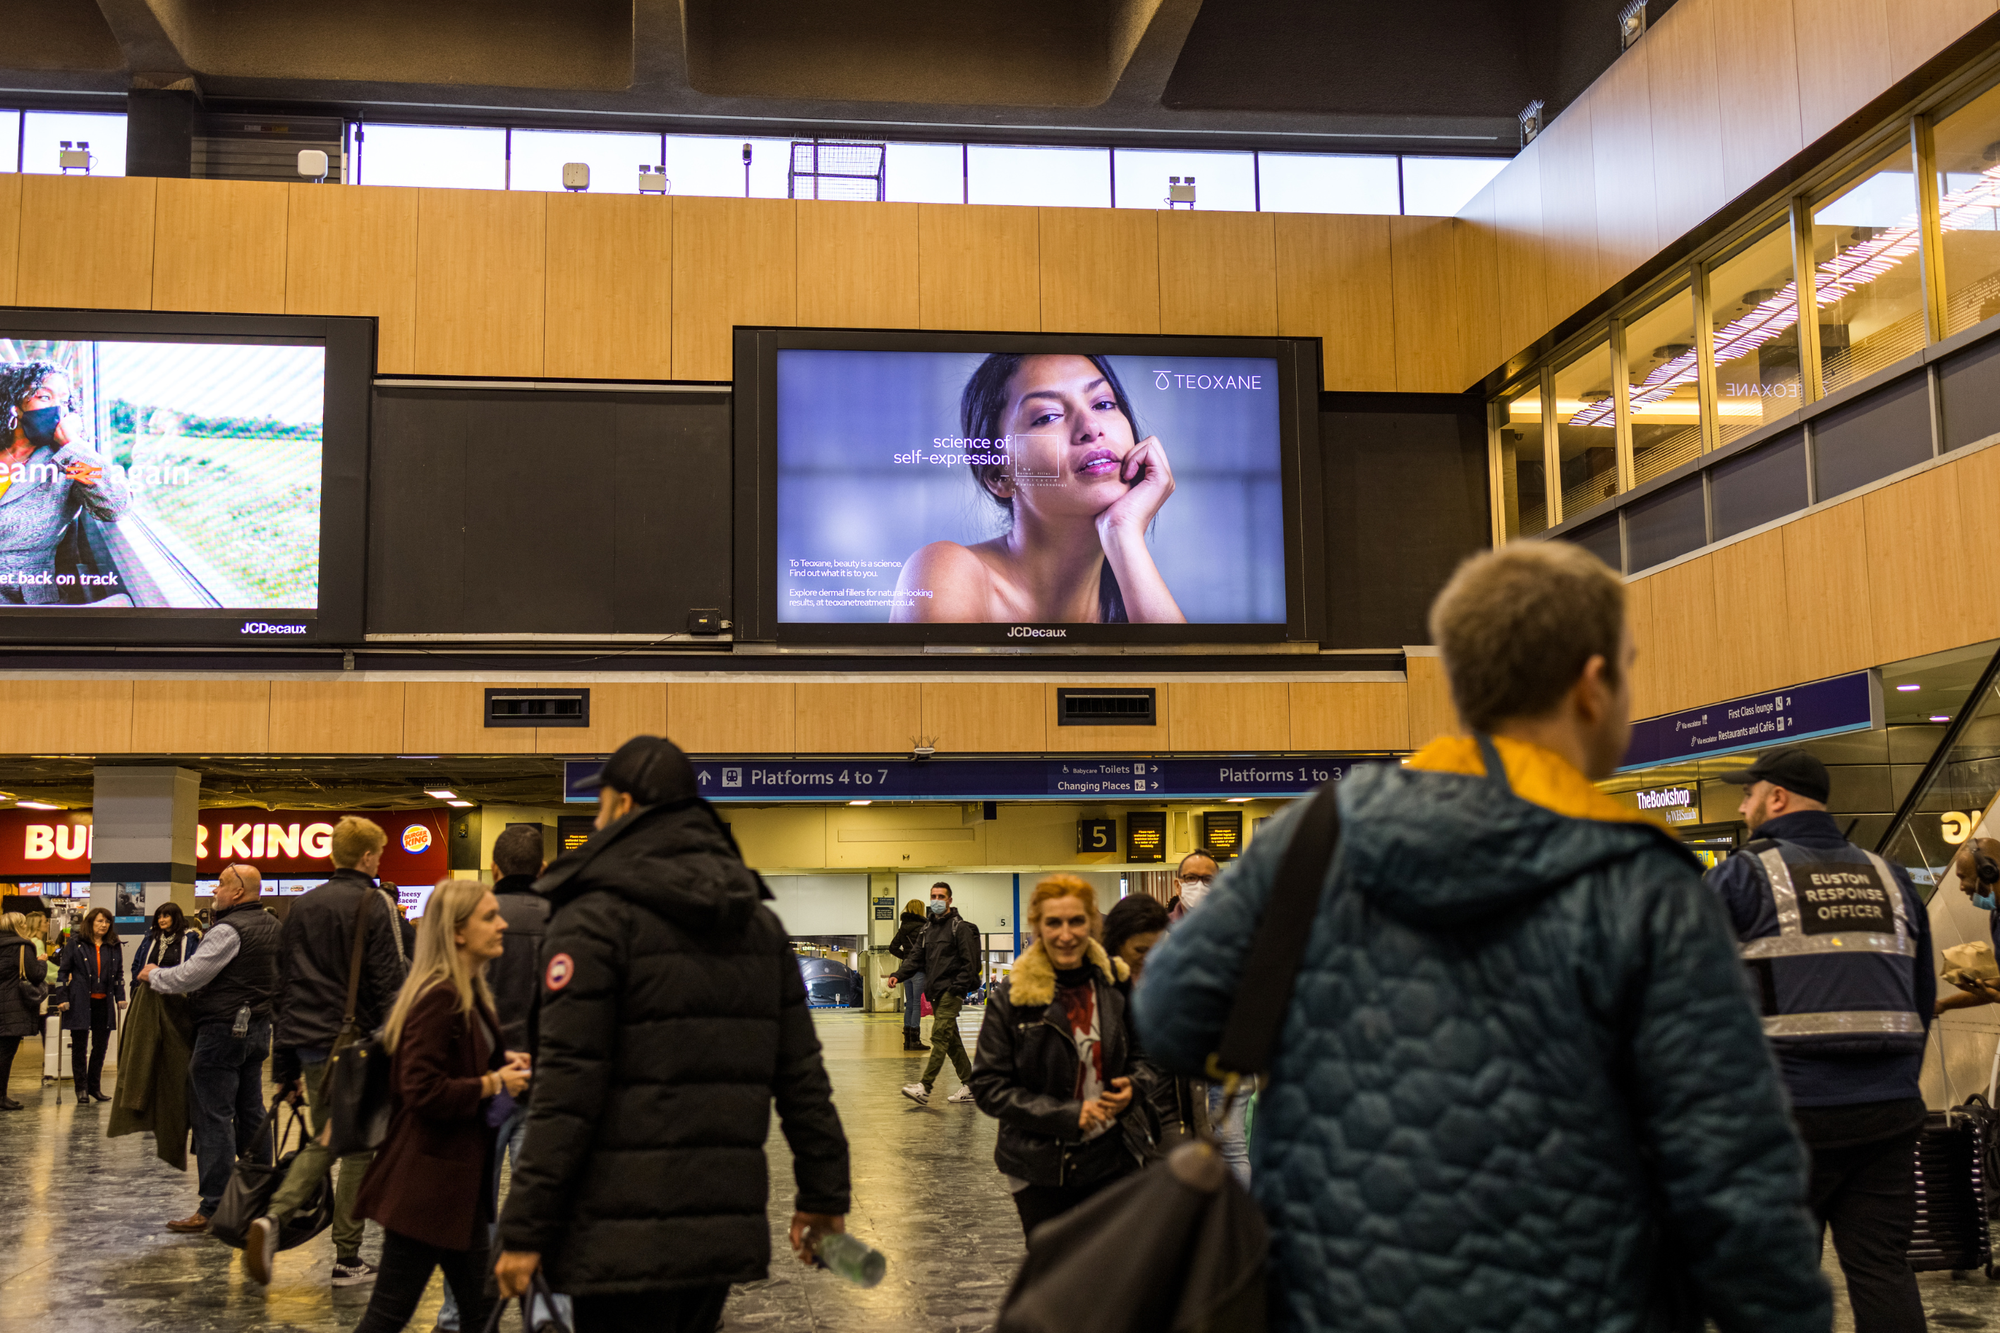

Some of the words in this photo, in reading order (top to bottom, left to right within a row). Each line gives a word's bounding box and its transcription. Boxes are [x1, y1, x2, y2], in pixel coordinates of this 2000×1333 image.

[1173, 374, 1262, 390] TEOXANE
[933, 434, 991, 449] science
[994, 434, 1011, 449] of
[893, 449, 1011, 468] self-expression
[110, 459, 190, 492] again
[789, 559, 799, 568] To
[800, 559, 833, 568] Teoxane,
[834, 559, 860, 569] beauty
[873, 559, 903, 568] science.
[18, 570, 53, 585] back
[56, 573, 76, 585] on
[79, 571, 119, 586] track
[789, 569, 806, 577] Find
[821, 569, 839, 577] what
[840, 569, 846, 577] it
[862, 571, 878, 579] you.
[789, 588, 818, 599] Explore
[818, 588, 845, 597] dermal
[845, 588, 865, 597] fillers
[866, 588, 878, 597] for
[878, 588, 933, 599] natural-looking
[789, 598, 815, 607] results,
[241, 622, 307, 635] JCDecaux
[1007, 626, 1067, 638] JCDecaux
[1728, 709, 1741, 720] First
[1740, 706, 1755, 717] Class
[1754, 702, 1774, 714] lounge
[1718, 727, 1748, 741] Restaurants
[1748, 723, 1759, 735] and
[1759, 720, 1775, 733] Cafés
[751, 769, 834, 785] Platforms
[838, 769, 850, 785] 4
[854, 771, 873, 785] to
[877, 769, 888, 785] 7
[1072, 767, 1098, 775] Babycare
[1099, 764, 1130, 774] Toilets
[1219, 767, 1294, 782] Platforms
[1298, 767, 1308, 782] 1
[1312, 768, 1329, 782] to
[1332, 767, 1343, 782] 3
[1057, 781, 1100, 792] Changing
[1102, 781, 1131, 791] Places
[1636, 787, 1690, 810] TheBookshop
[1665, 811, 1672, 824] by
[219, 822, 334, 860] KING
[404, 830, 428, 841] BURGER
[404, 835, 428, 848] KING
[1092, 825, 1108, 848] 5
[1810, 872, 1871, 886] EUSTON
[1804, 887, 1886, 902] RESPONSE
[1817, 904, 1884, 920] OFFICER
[1000, 918, 1006, 927] 5
